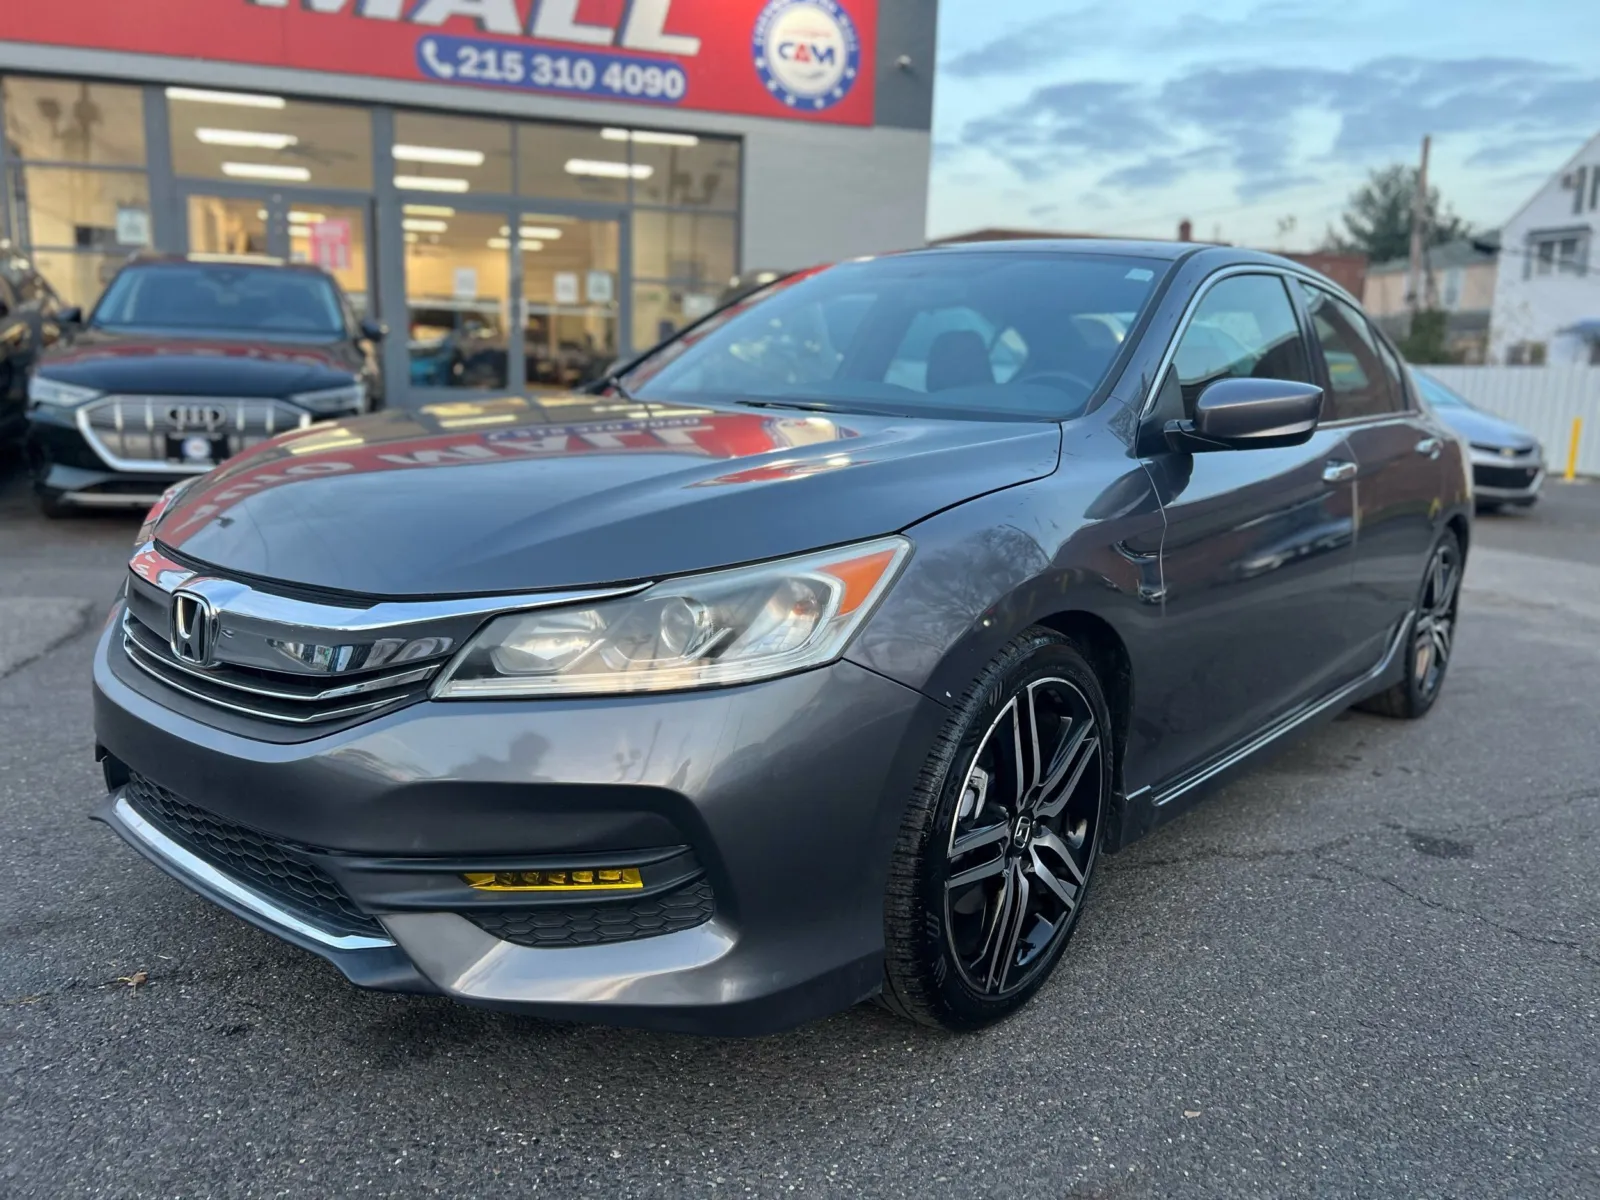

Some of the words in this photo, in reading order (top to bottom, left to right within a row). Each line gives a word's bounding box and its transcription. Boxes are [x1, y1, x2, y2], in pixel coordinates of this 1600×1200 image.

[244, 0, 701, 56] LL
[778, 42, 835, 67] CAM
[457, 45, 525, 83] 215
[531, 54, 596, 90] 310
[602, 61, 686, 99] 4090
